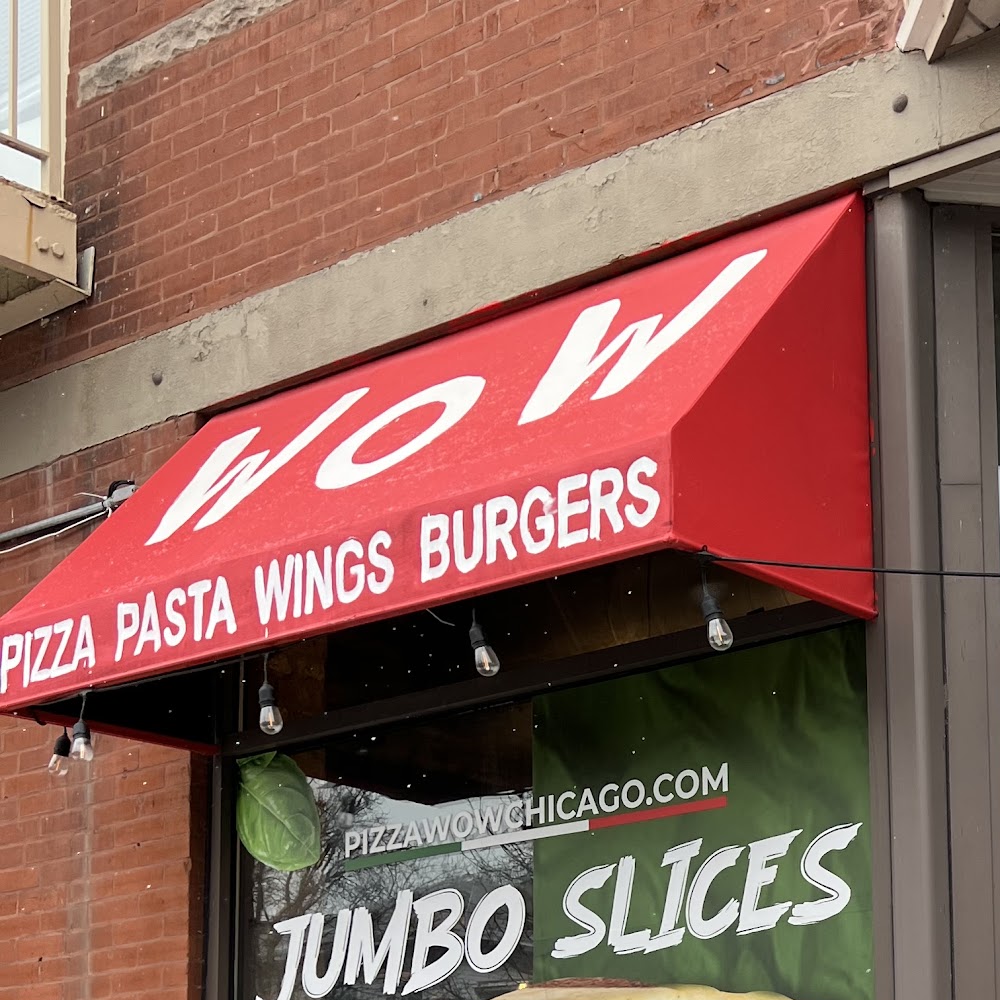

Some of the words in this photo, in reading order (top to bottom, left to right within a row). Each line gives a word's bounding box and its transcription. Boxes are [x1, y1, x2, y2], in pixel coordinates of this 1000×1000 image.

[145, 248, 767, 546] WOW
[0, 613, 95, 695] PIZZA
[115, 575, 237, 661] PASTA
[255, 530, 394, 626] WINGS
[420, 456, 661, 583] BURGERS
[344, 762, 730, 859] PIZZAWOWCHICAGO.COM
[551, 822, 863, 959] SLICES
